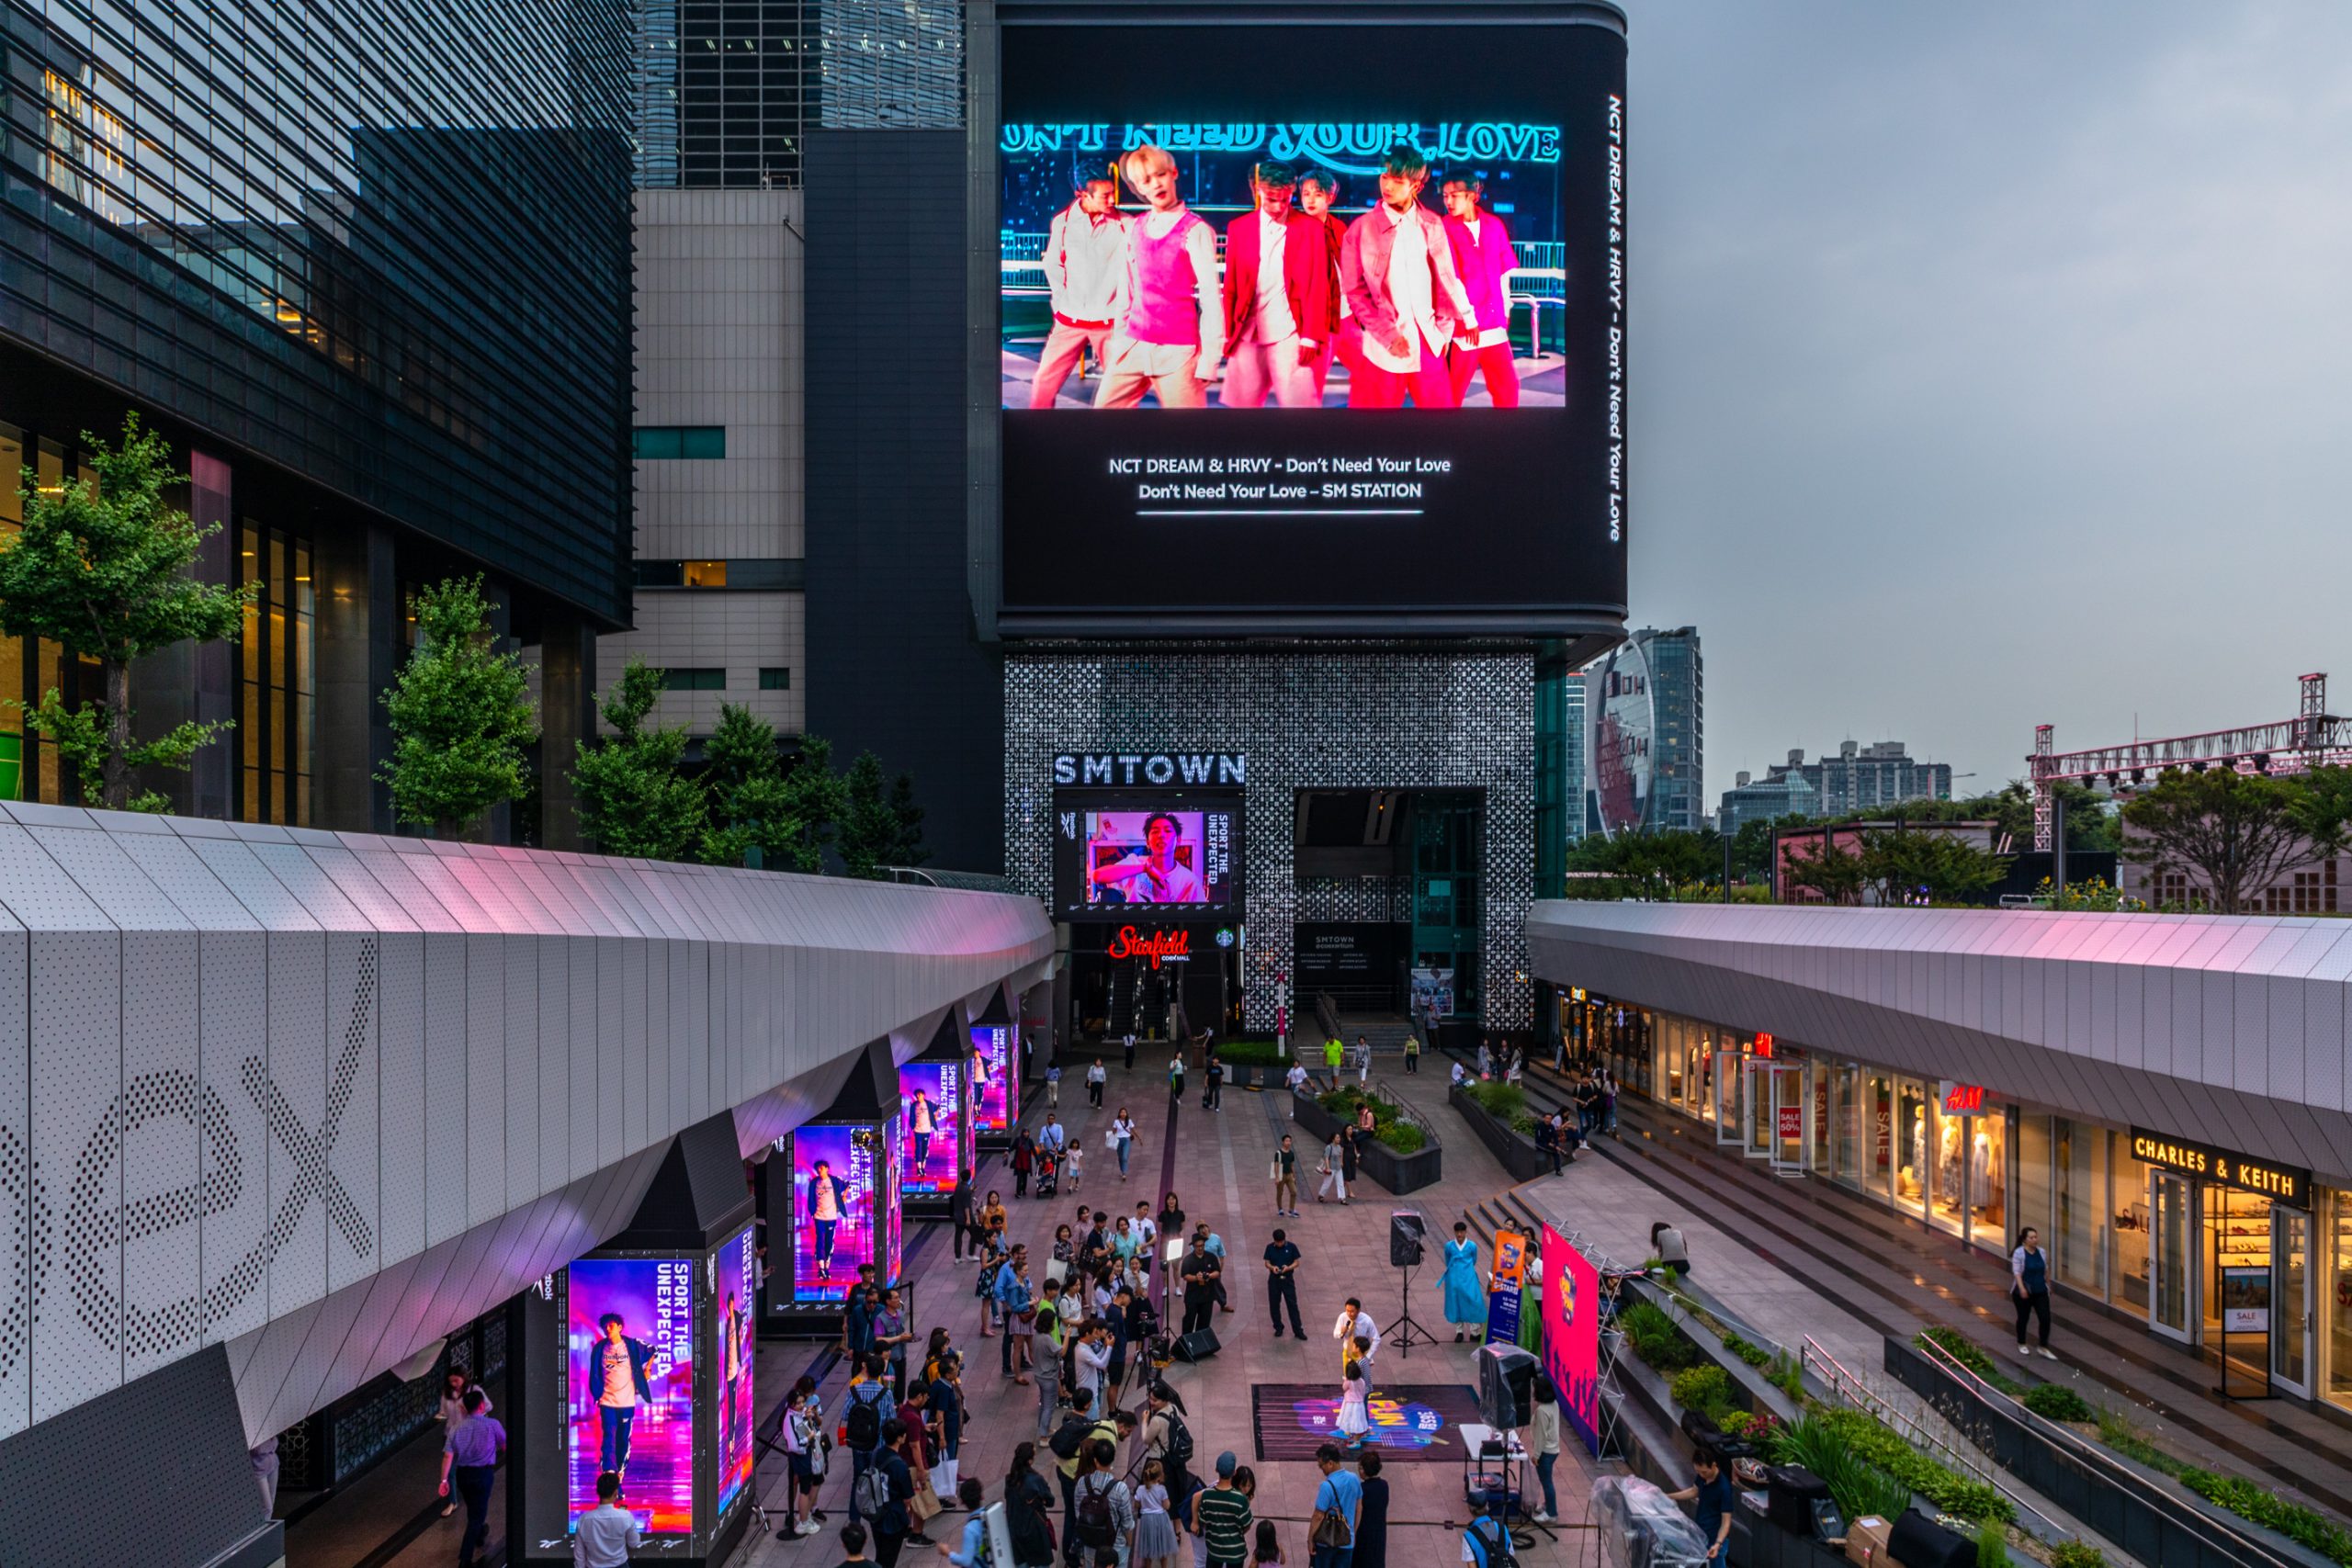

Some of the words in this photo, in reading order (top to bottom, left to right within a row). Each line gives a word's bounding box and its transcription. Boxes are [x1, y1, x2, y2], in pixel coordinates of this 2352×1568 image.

[1610, 95, 1621, 144] NCT
[1436, 122, 1560, 163] LOVE
[1610, 145, 1621, 225] DREAM
[1610, 227, 1621, 243] &
[1610, 246, 1621, 310] HRVY
[1610, 327, 1622, 380] Don't
[1610, 384, 1622, 438] Need
[1109, 458, 1142, 473] NCT
[1147, 458, 1204, 473] DREAM
[1208, 458, 1224, 473] &
[1227, 457, 1272, 473] HRVY
[1286, 457, 1329, 472] Don't
[1332, 457, 1373, 472] Need
[1376, 457, 1411, 472] Your
[1415, 457, 1451, 472] Love
[1610, 443, 1622, 490] Your
[1138, 484, 1181, 499] Don't
[1184, 483, 1226, 499] Need
[1228, 484, 1266, 499] Your
[1269, 483, 1306, 498] Love
[1322, 483, 1347, 498] SM
[1351, 483, 1422, 498] STATION
[1610, 493, 1621, 542] Love
[1055, 754, 1246, 784] SMTOWN
[1208, 815, 1218, 885] UNEXPECTED
[1218, 815, 1228, 850] SPORT
[1218, 852, 1228, 874] THE
[1108, 925, 1189, 970] Starfield
[1315, 935, 1354, 943] SMTOWN
[940, 1066, 948, 1118] UNEXPECTED
[948, 1066, 956, 1091] SPORT
[1947, 1086, 1984, 1111] H&M
[1780, 1123, 1801, 1132] 50%
[1815, 1091, 1826, 1132] SALE
[1876, 1112, 1890, 1156] SALE
[2135, 1137, 2205, 1172] CHARLES
[2216, 1158, 2228, 1179] &
[2240, 1164, 2294, 1197] KEITH
[673, 1263, 689, 1318] SPORT
[657, 1263, 672, 1377] UNEXPECTED
[2236, 1312, 2256, 1320] SALE
[673, 1325, 689, 1357] THE
